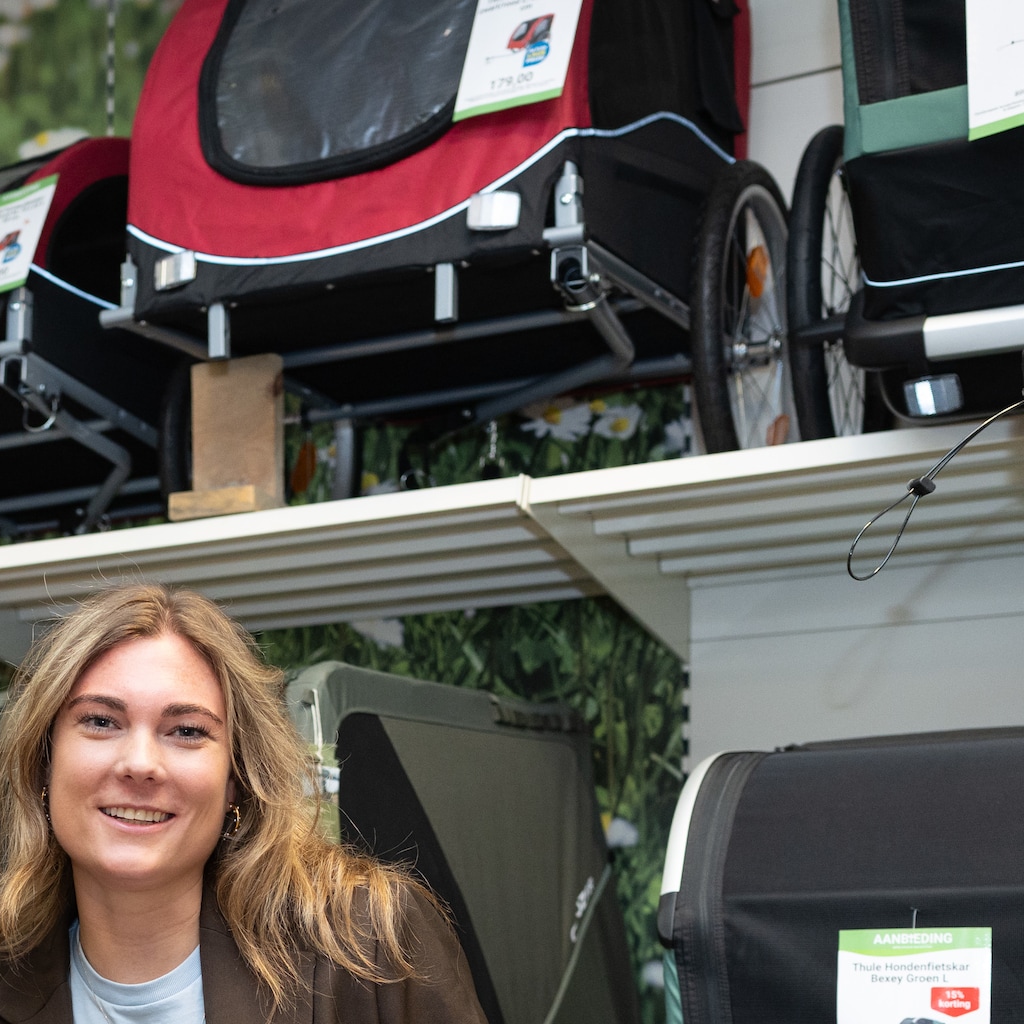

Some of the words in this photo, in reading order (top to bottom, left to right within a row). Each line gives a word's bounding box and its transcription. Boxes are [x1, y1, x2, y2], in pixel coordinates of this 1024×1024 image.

[873, 932, 953, 945] AANBIEDING
[853, 962, 882, 972] Thule
[884, 961, 970, 972] Hondenfietskar
[871, 974, 903, 984] Bexey
[906, 973, 940, 983] Groen
[942, 973, 949, 983] L
[938, 999, 971, 1010] korting
